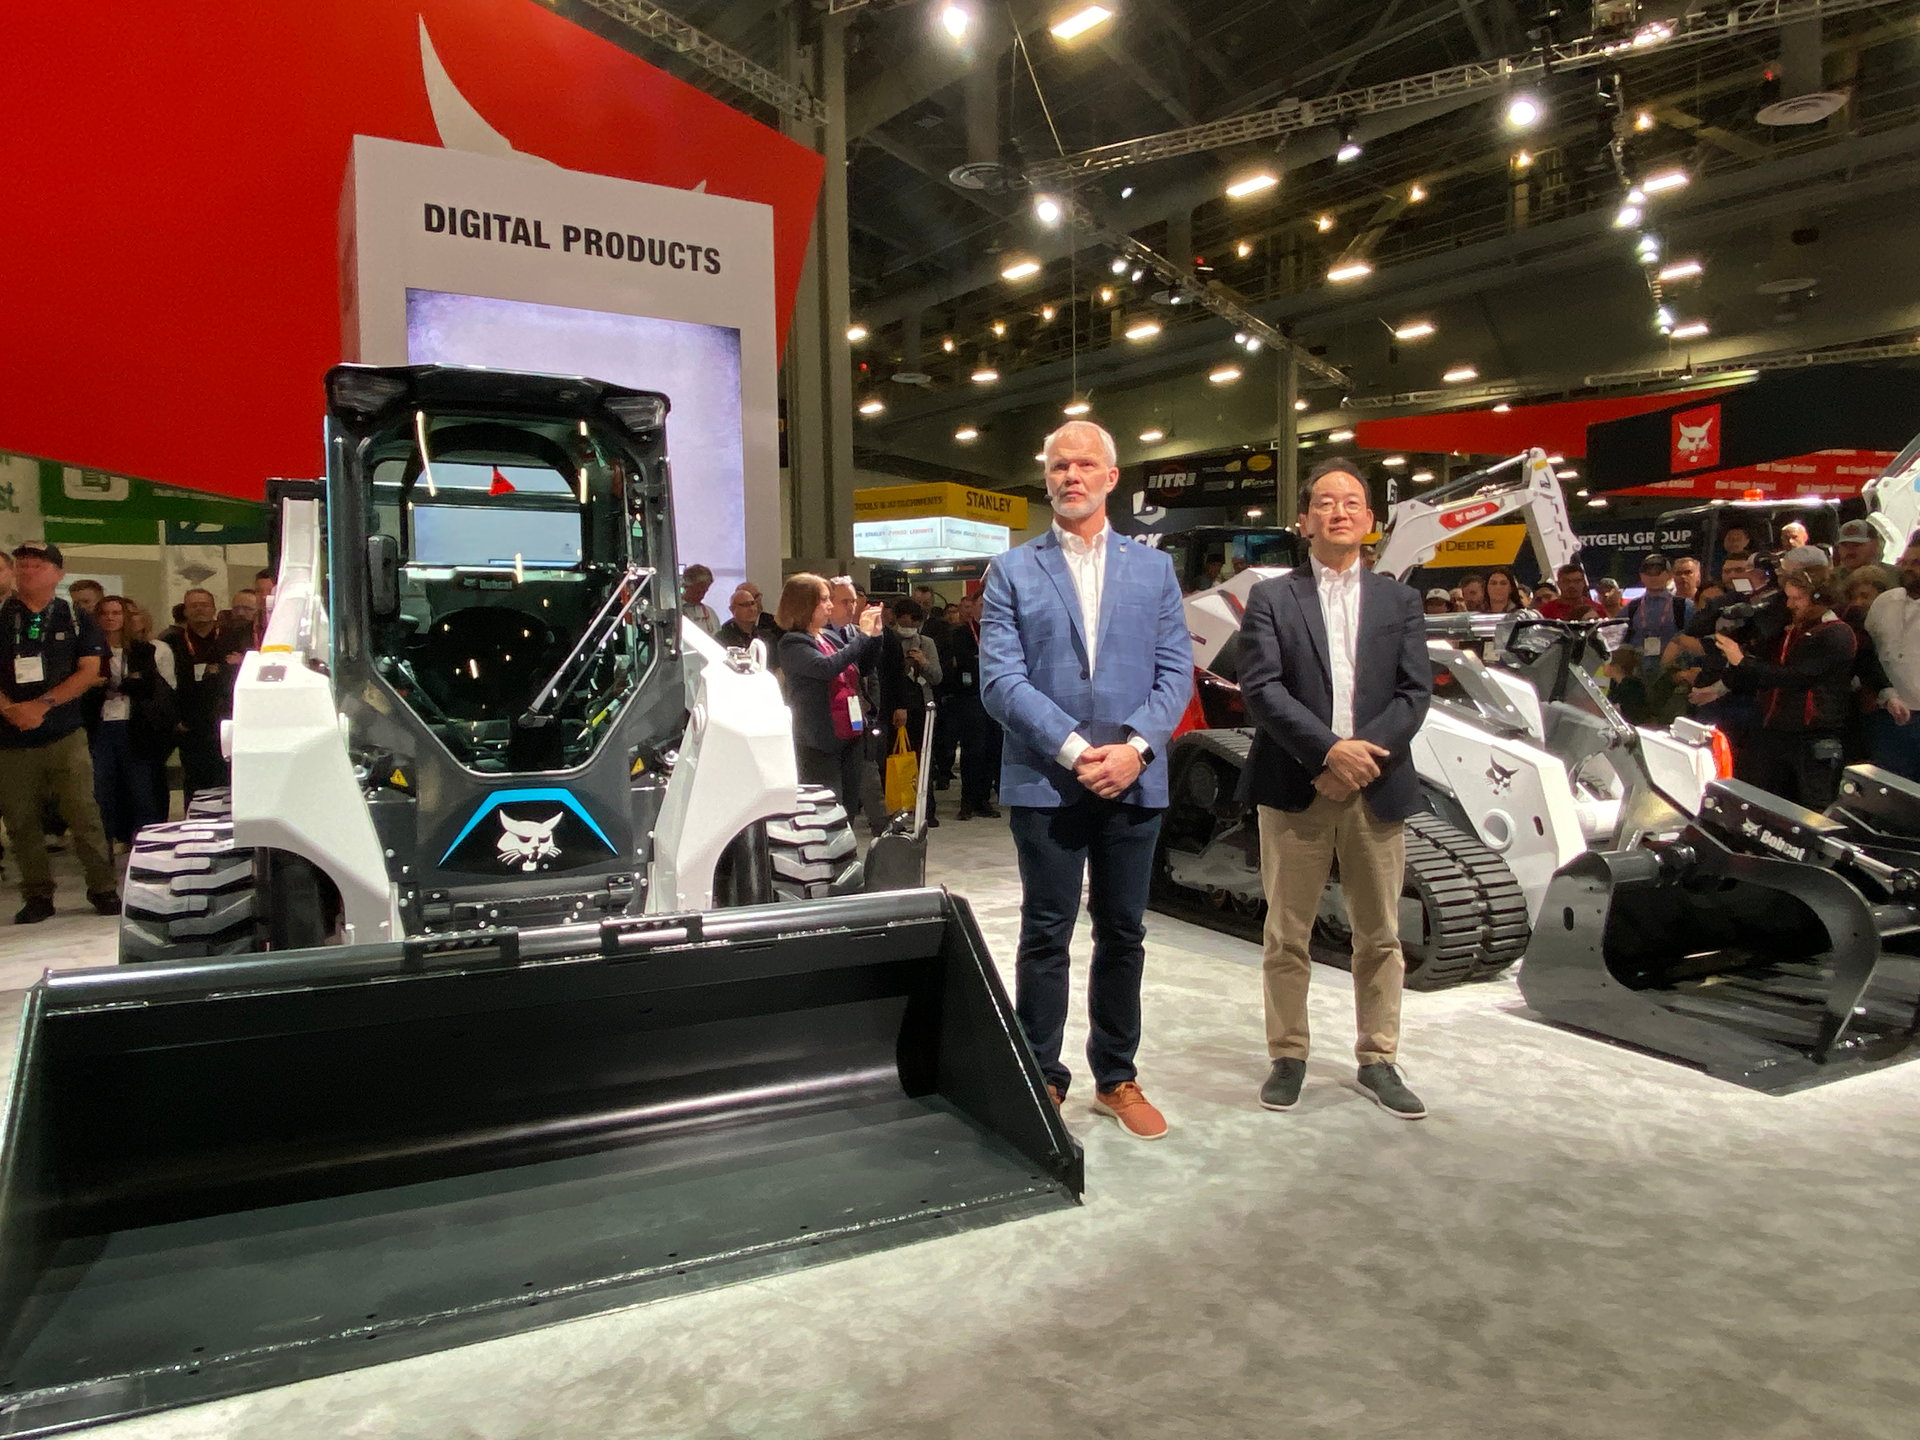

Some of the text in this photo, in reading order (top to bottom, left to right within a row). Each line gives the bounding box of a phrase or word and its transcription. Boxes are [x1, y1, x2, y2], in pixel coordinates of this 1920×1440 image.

[424, 203, 721, 275] DIGITAL PRODUCTS
[966, 490, 1012, 513] STANLEY
[1126, 533, 1163, 549] CK
[1446, 540, 1496, 552] DEERE
[1578, 530, 1692, 546] RTGEN GROUP
[1760, 829, 1806, 862] Bobcat
